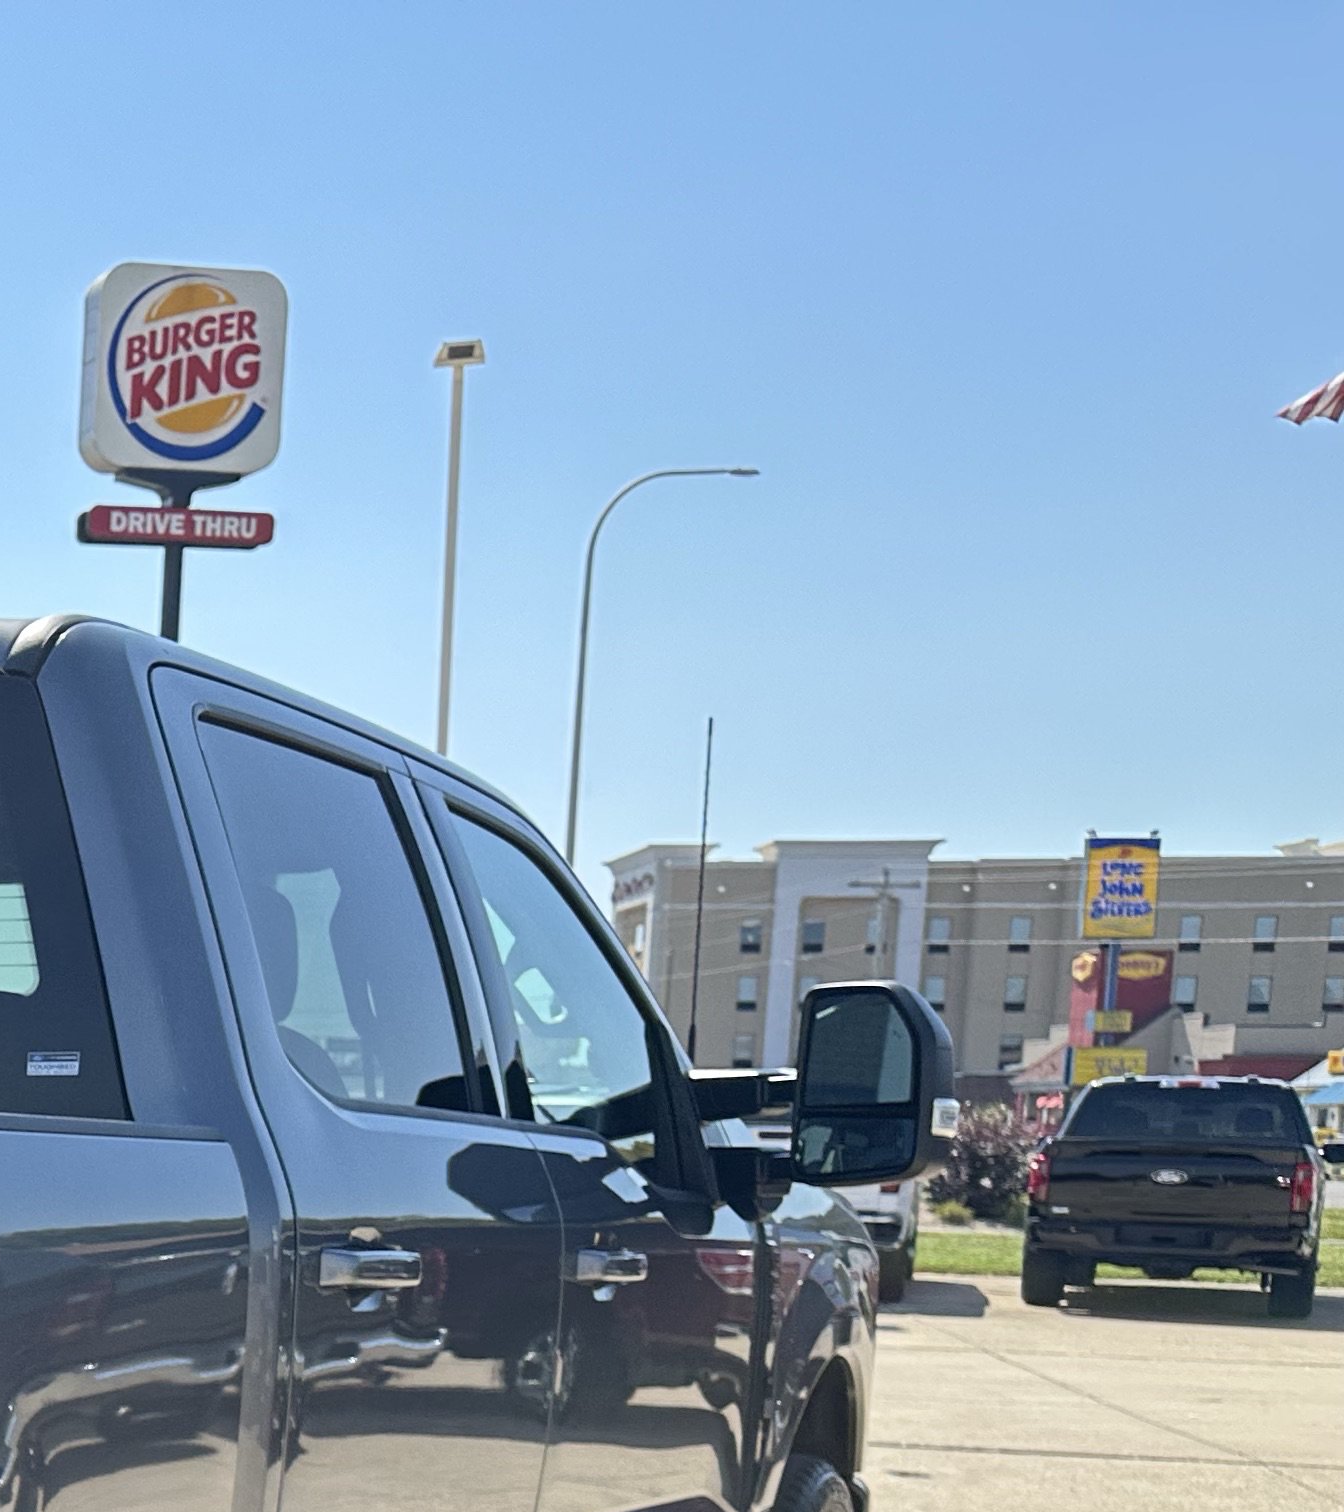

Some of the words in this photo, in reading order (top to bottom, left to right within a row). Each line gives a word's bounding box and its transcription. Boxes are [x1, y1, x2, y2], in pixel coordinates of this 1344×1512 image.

[124, 310, 257, 371] BURGER
[127, 342, 261, 421] KING
[110, 511, 185, 536] DRIVE
[193, 513, 257, 539] THRU
